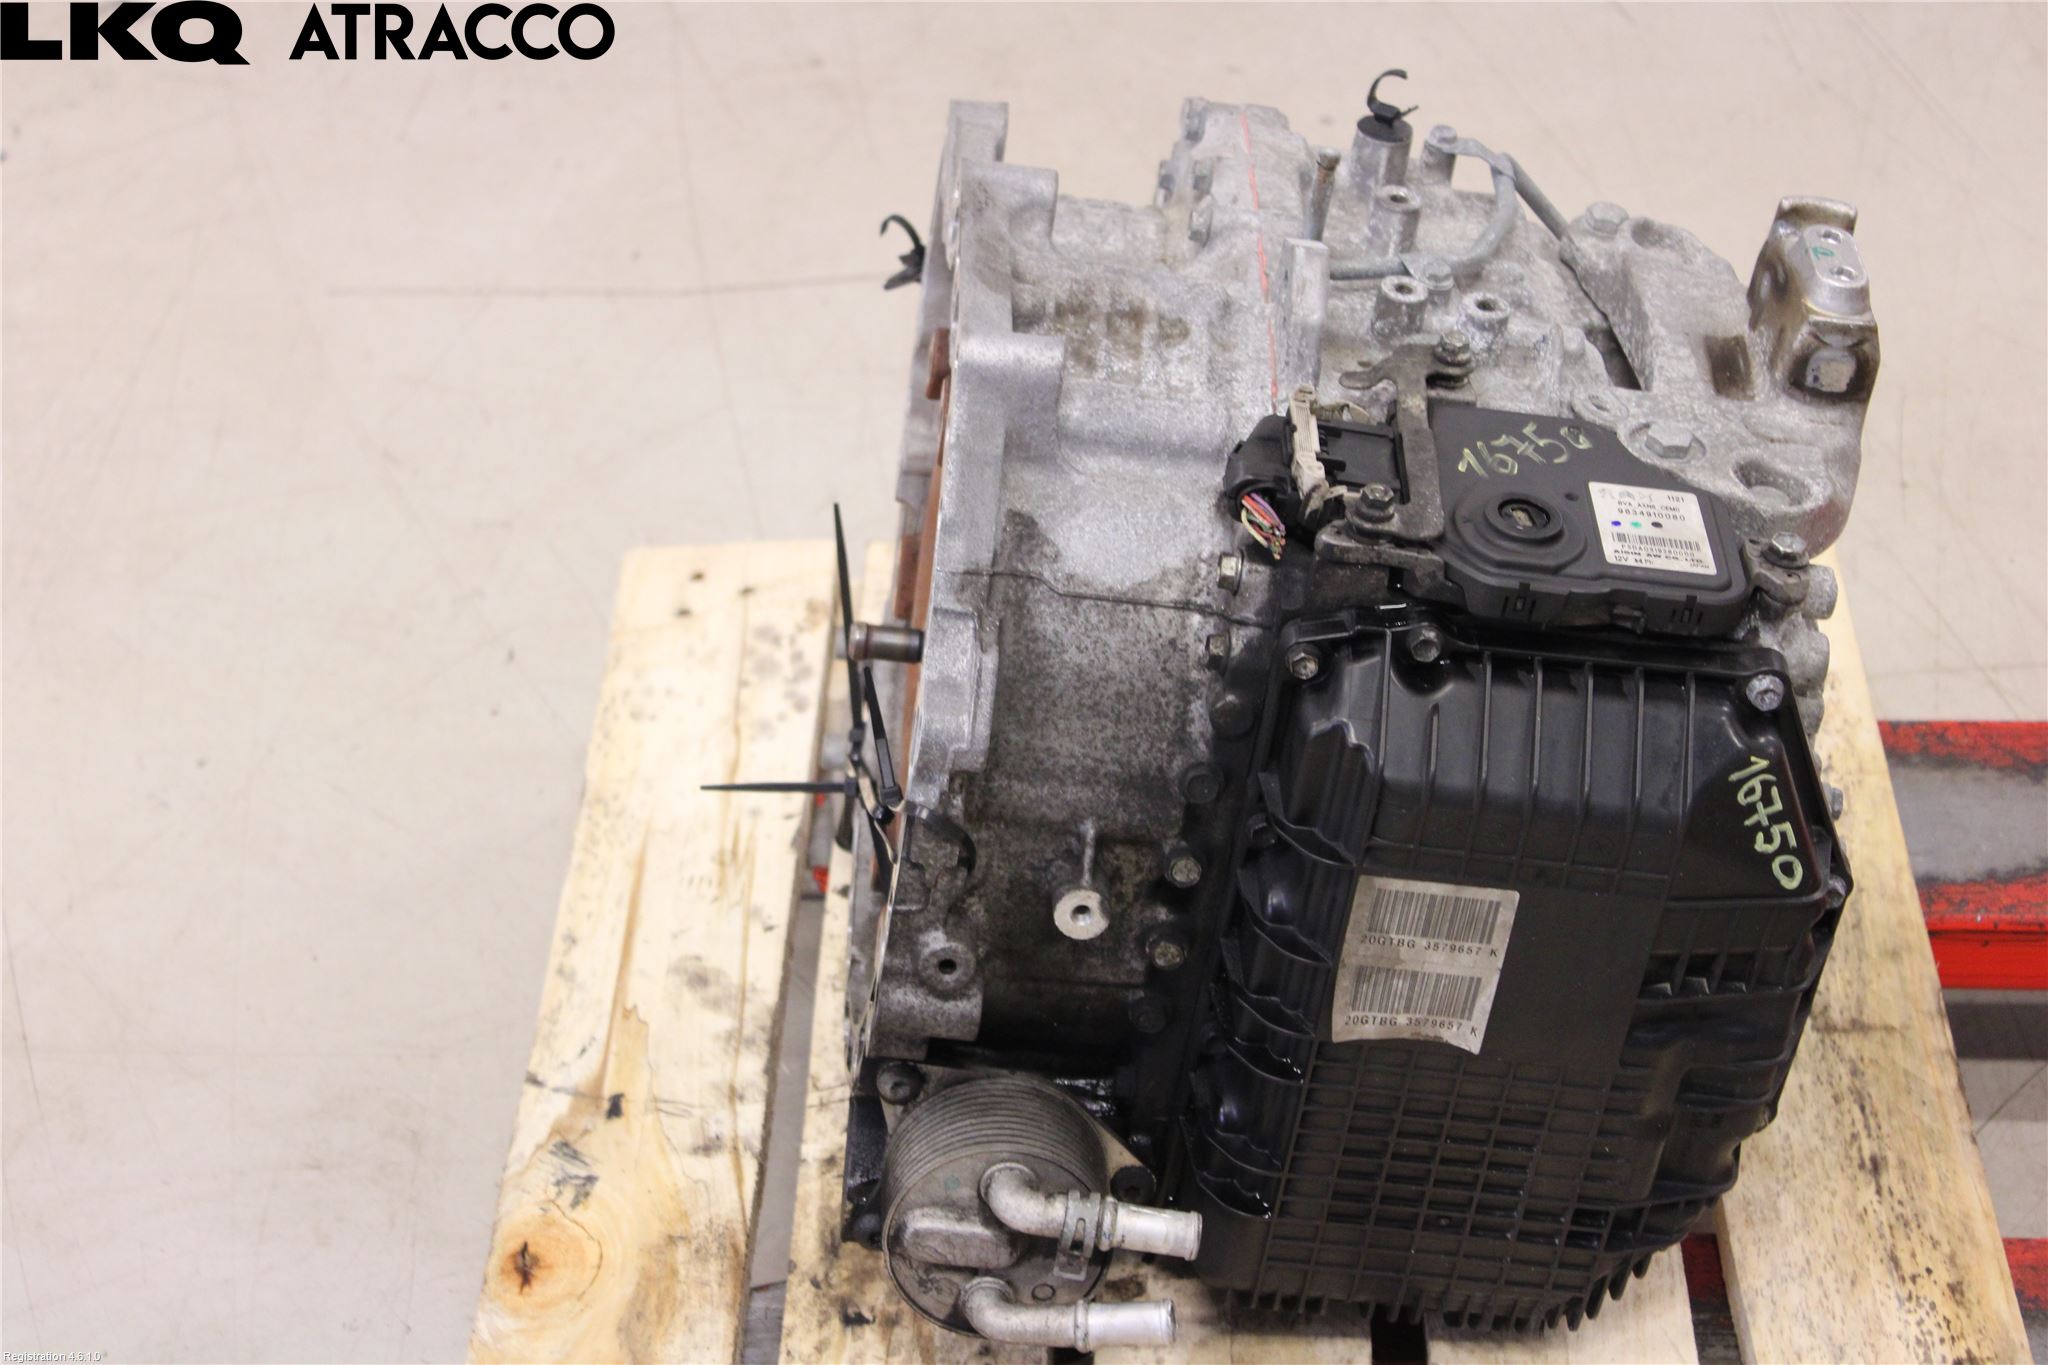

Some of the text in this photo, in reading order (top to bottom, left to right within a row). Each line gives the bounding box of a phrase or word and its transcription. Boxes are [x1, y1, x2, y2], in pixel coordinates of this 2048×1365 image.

[1728, 755, 1803, 890] 16750
[1424, 941, 1483, 956] 3579657
[1489, 948, 1499, 958] K
[1406, 1017, 1464, 1032] 3579657
[1470, 1026, 1478, 1038] K
